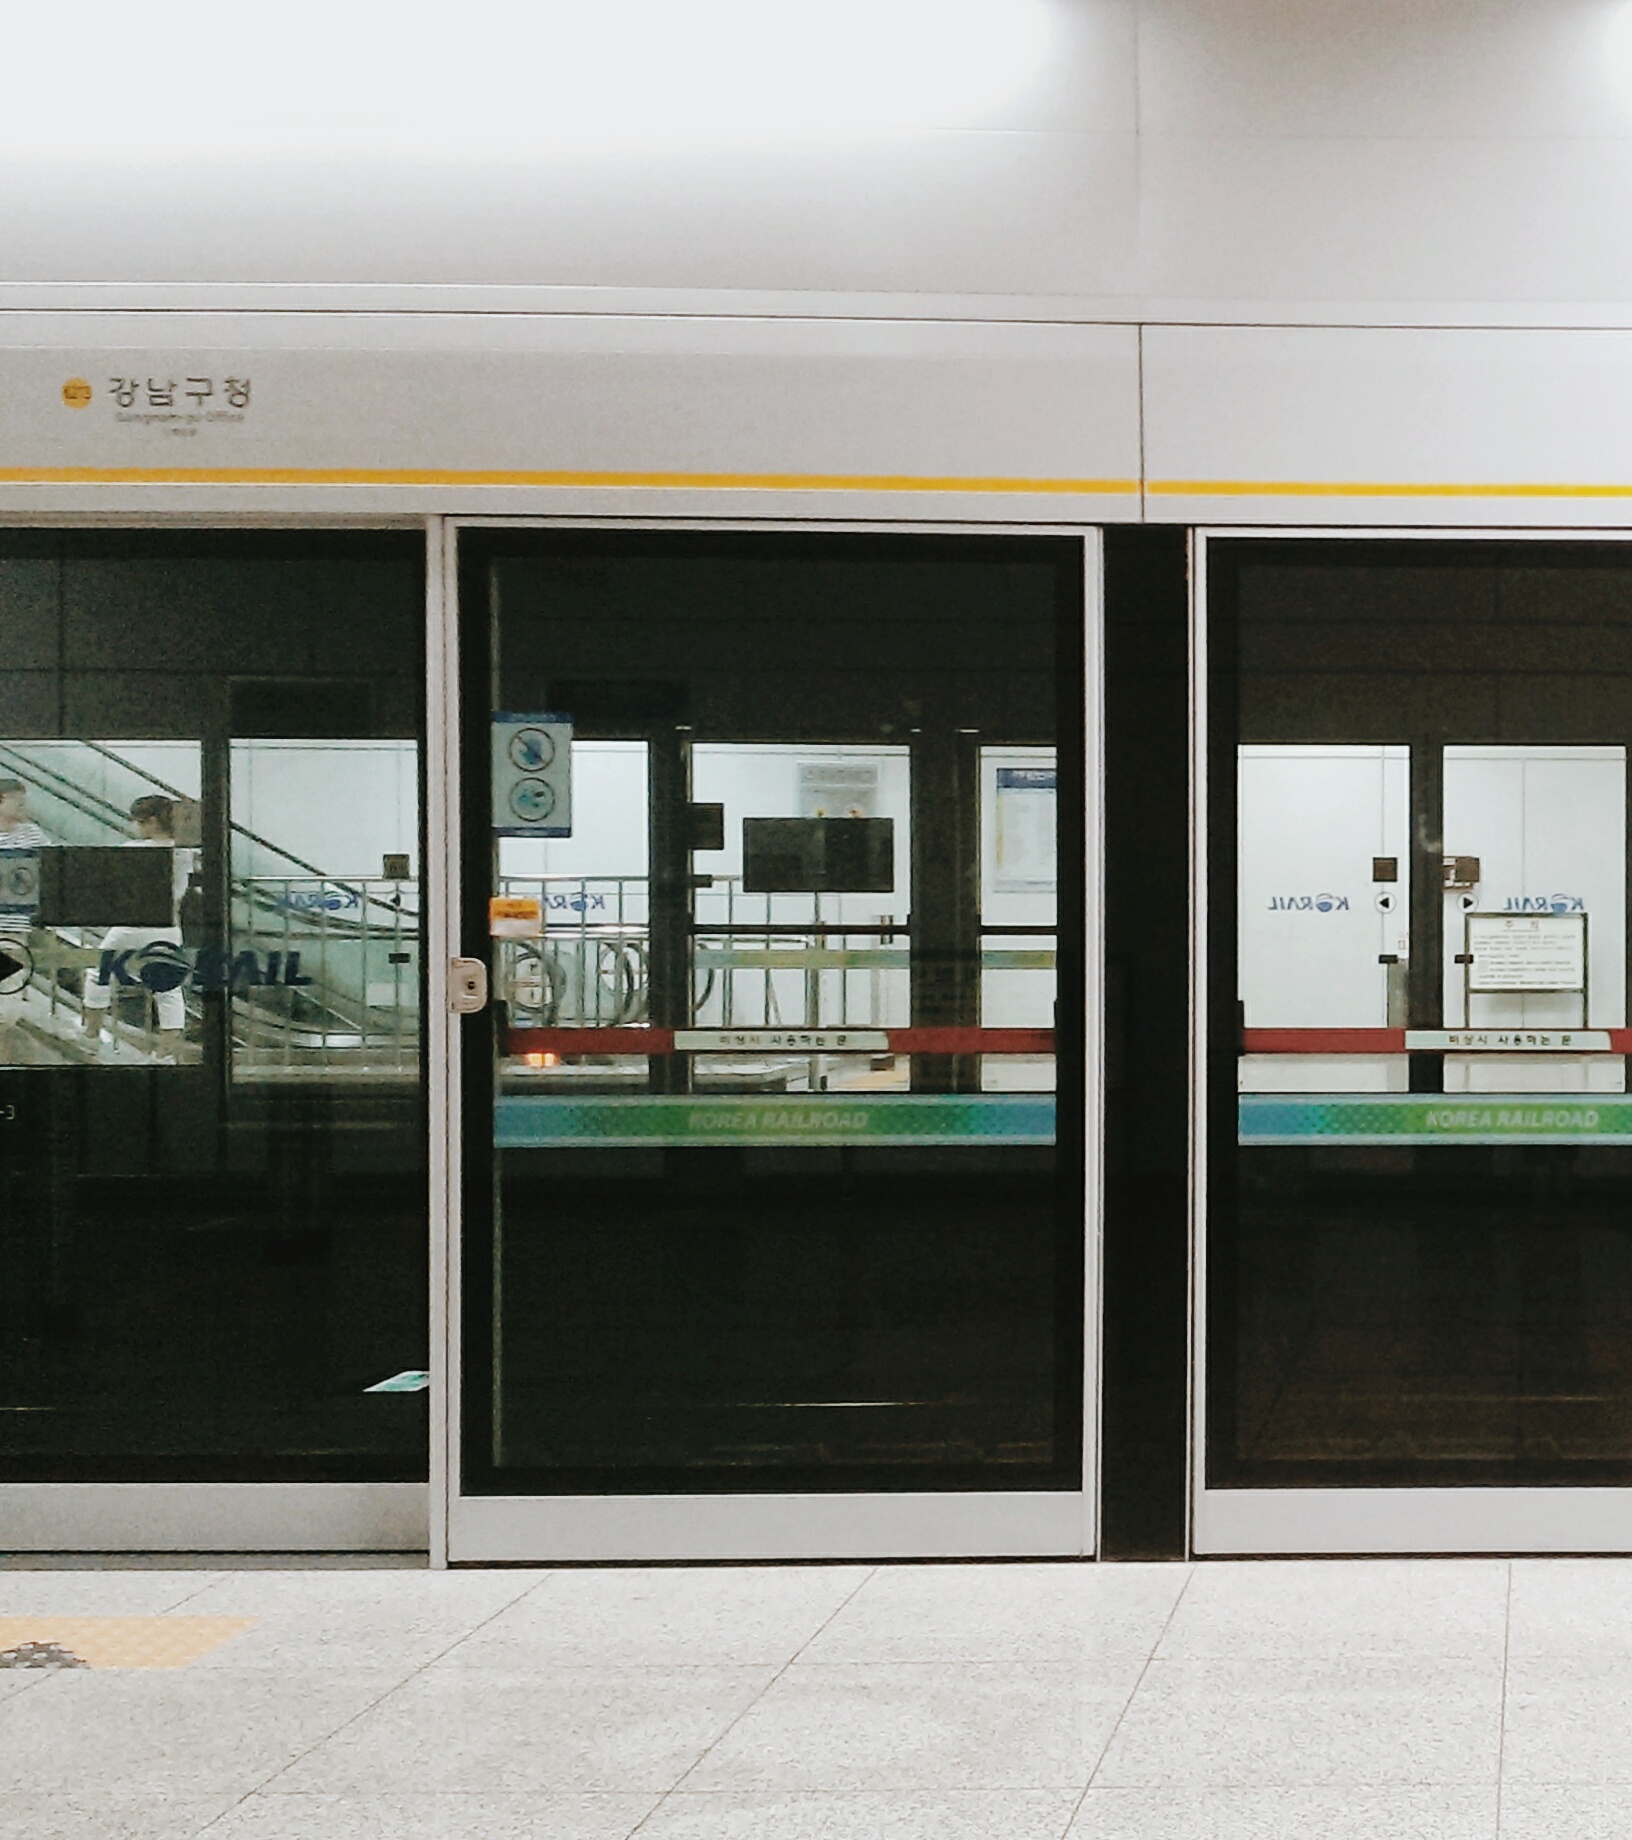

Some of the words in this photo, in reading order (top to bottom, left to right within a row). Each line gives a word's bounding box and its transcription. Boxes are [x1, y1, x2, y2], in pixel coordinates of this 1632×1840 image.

[106, 376, 250, 408] 강남구청
[690, 1112, 757, 1129] KOREA
[763, 1112, 868, 1129] RAILROAD
[1426, 1110, 1491, 1128] KOREA
[1496, 1110, 1599, 1127] RAILROAD
